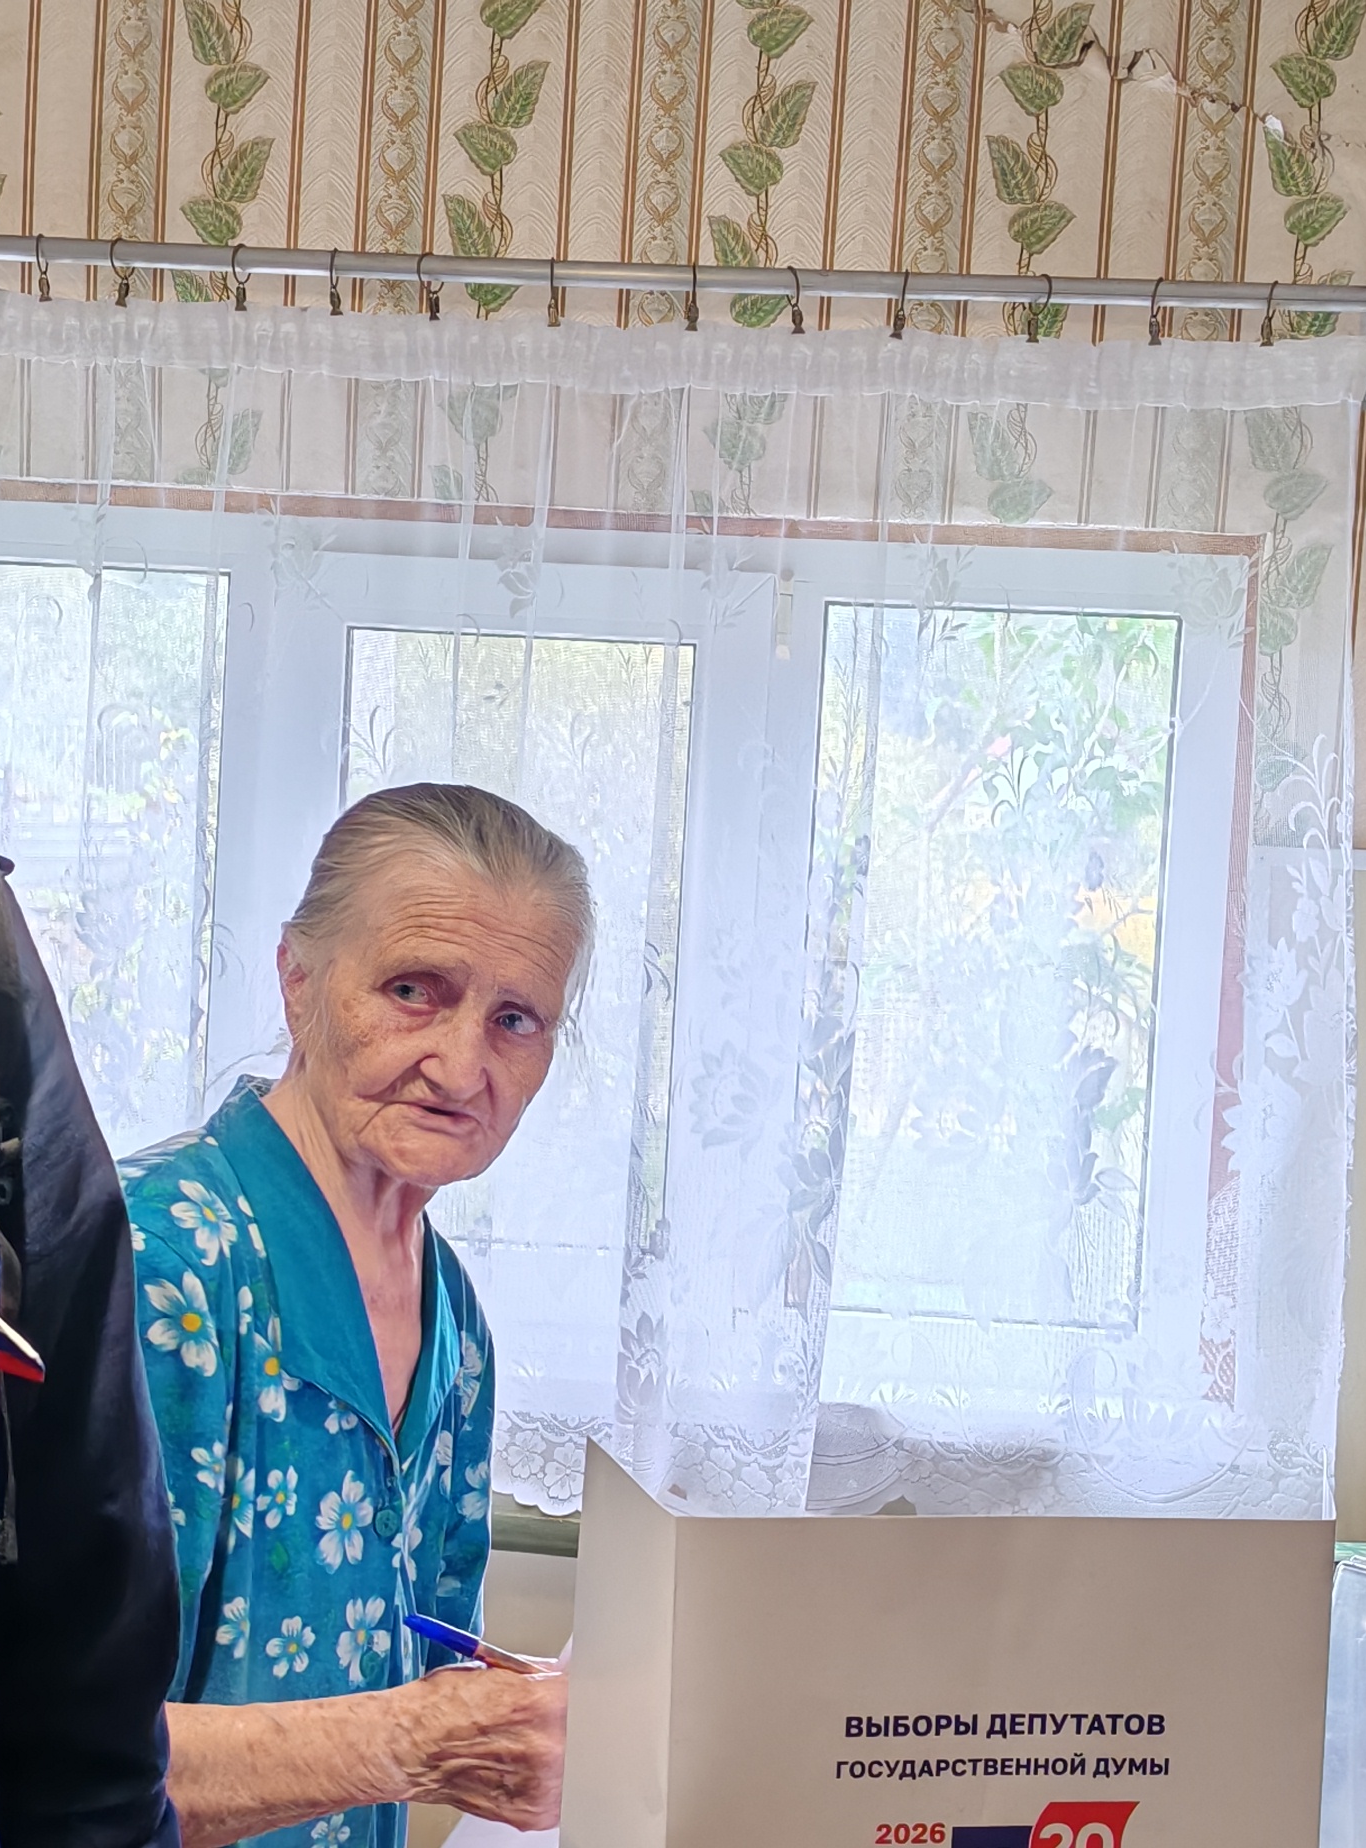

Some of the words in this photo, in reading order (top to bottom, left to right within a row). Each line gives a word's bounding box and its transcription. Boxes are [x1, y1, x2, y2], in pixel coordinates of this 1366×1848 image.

[844, 1713, 979, 1738] ВЫБОРЫ
[985, 1713, 1167, 1739] ДЕПУТАТОВ
[835, 1753, 1087, 1781] ГОСУДАРСТВЕННОЙ
[1092, 1757, 1171, 1780] ДУМЫ
[874, 1822, 946, 1845] 2026
